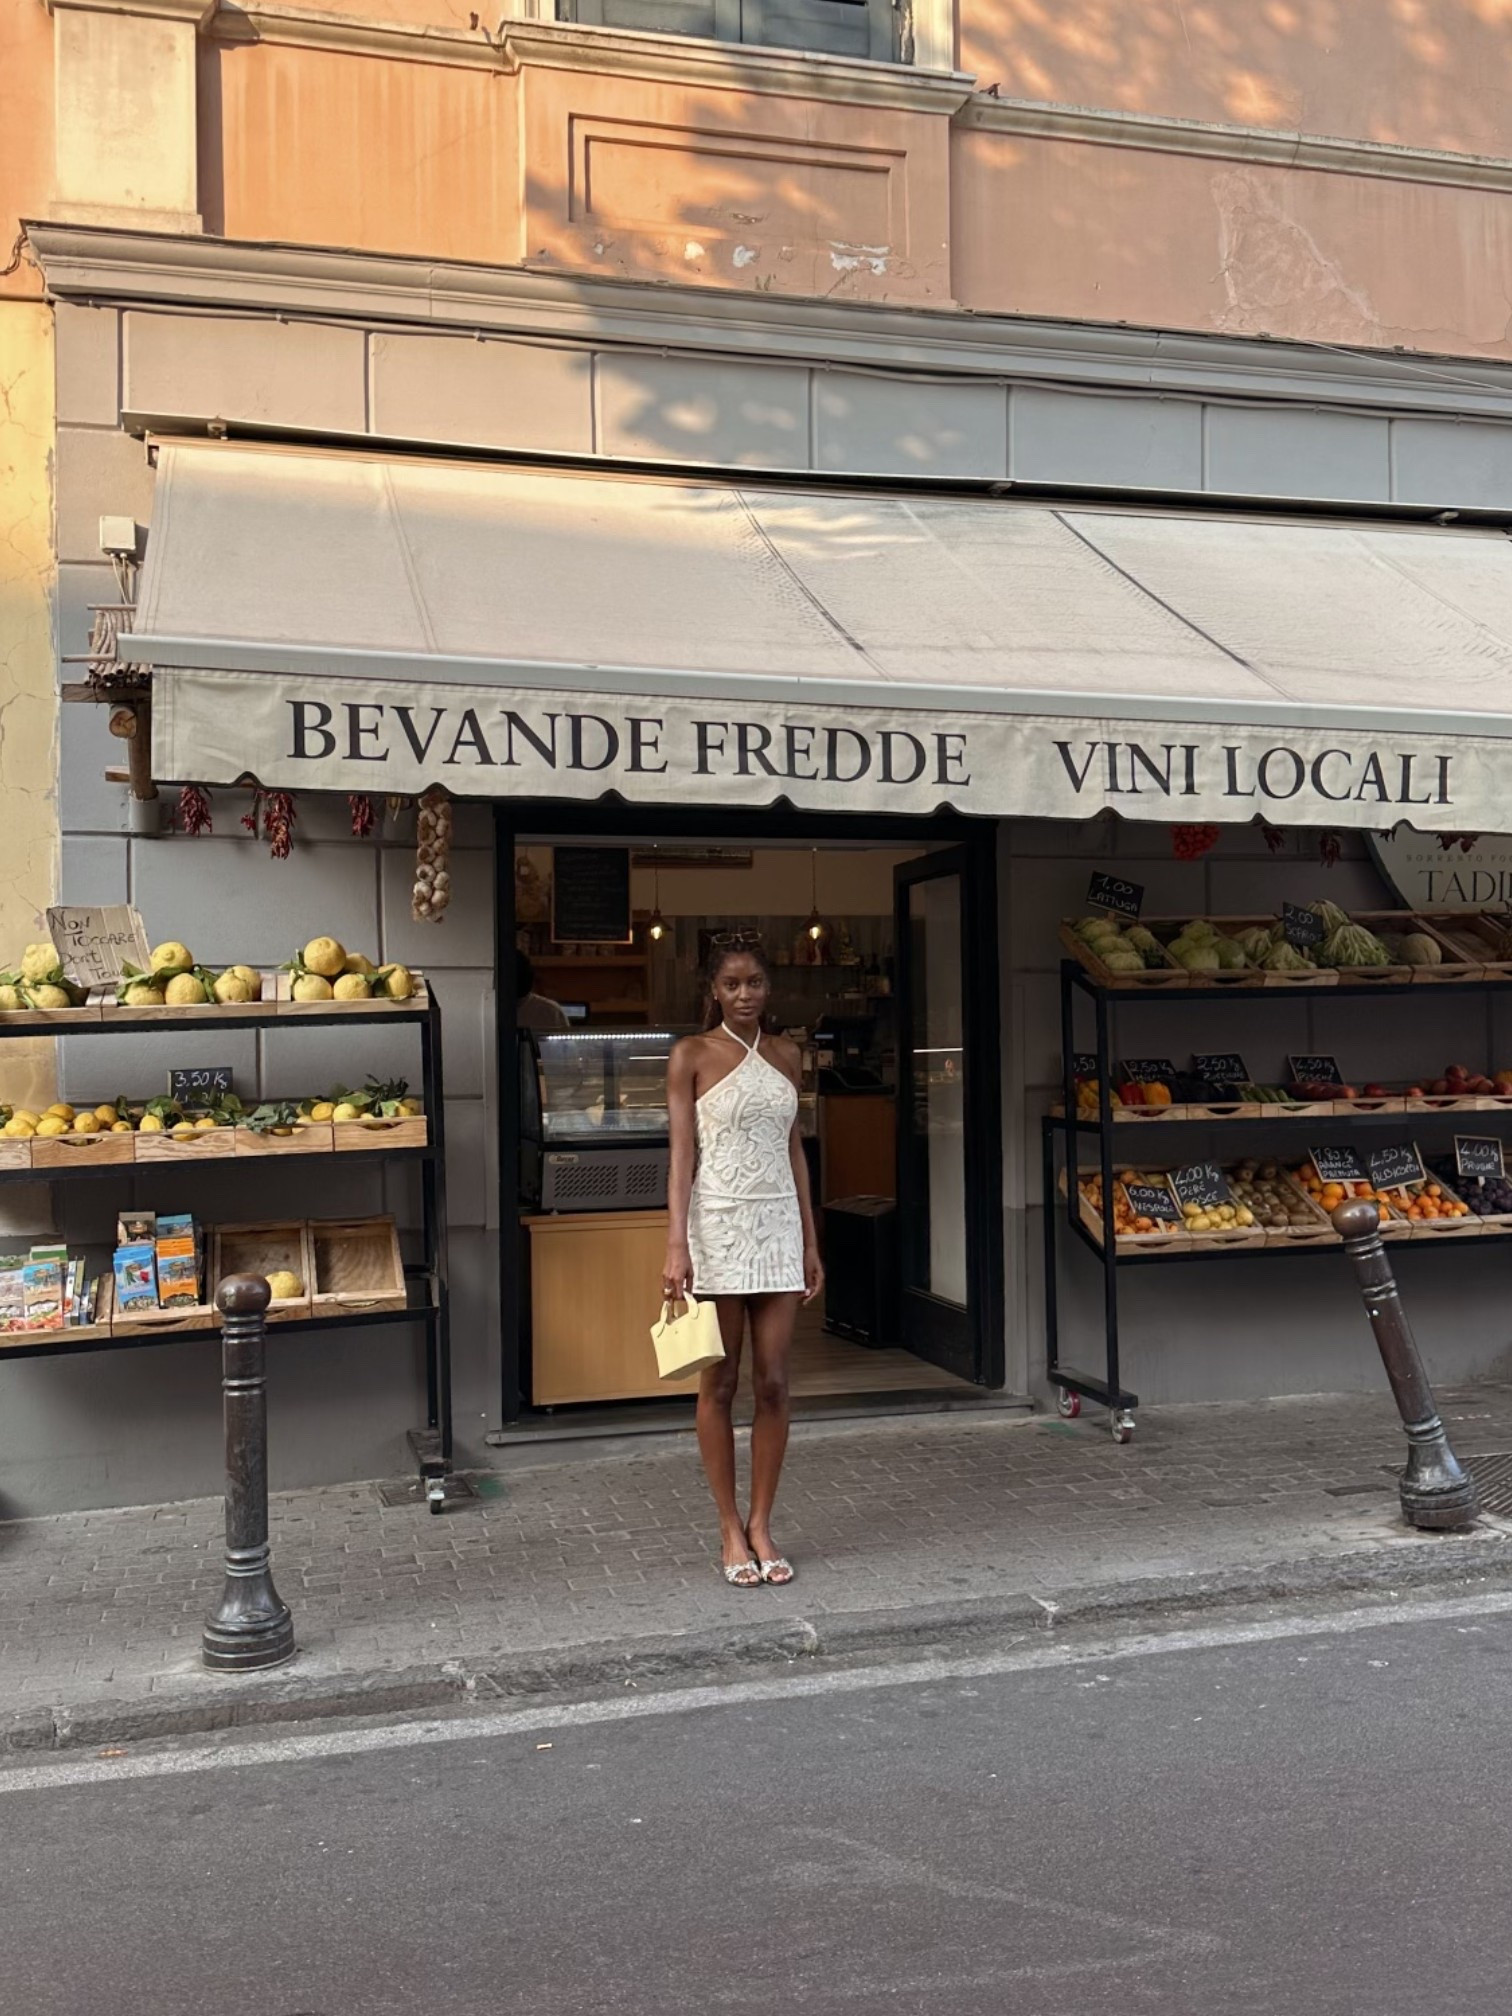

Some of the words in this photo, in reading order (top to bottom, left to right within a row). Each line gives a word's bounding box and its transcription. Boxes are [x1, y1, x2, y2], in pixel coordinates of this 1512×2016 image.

[286, 700, 669, 774] BEVANDE
[691, 720, 971, 787] FREDDE
[1052, 741, 1200, 796] VINI
[1222, 746, 1454, 804] LOCALI
[1418, 870, 1512, 903] TADI
